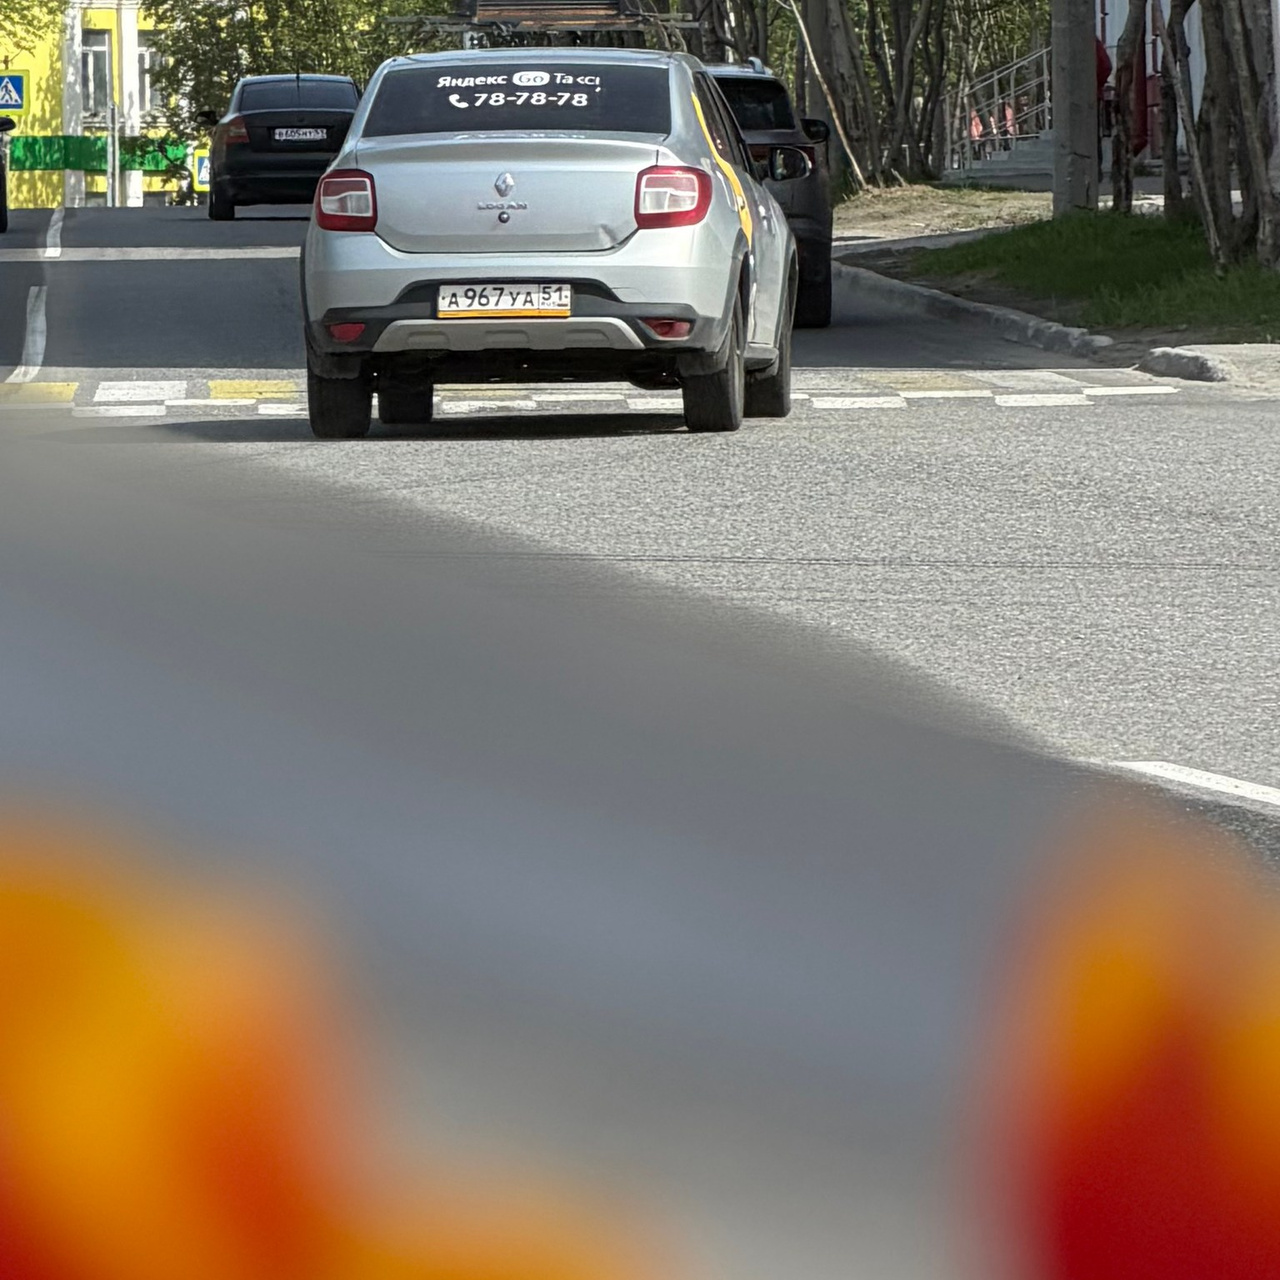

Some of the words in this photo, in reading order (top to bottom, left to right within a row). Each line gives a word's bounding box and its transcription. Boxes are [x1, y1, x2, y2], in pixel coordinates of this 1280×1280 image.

[437, 75, 508, 88] Яндекс
[516, 72, 547, 85] Go
[474, 92, 588, 107] 78-78-78
[477, 201, 528, 210] LOGAN
[447, 287, 534, 308] А967УА
[542, 286, 563, 301] 51
